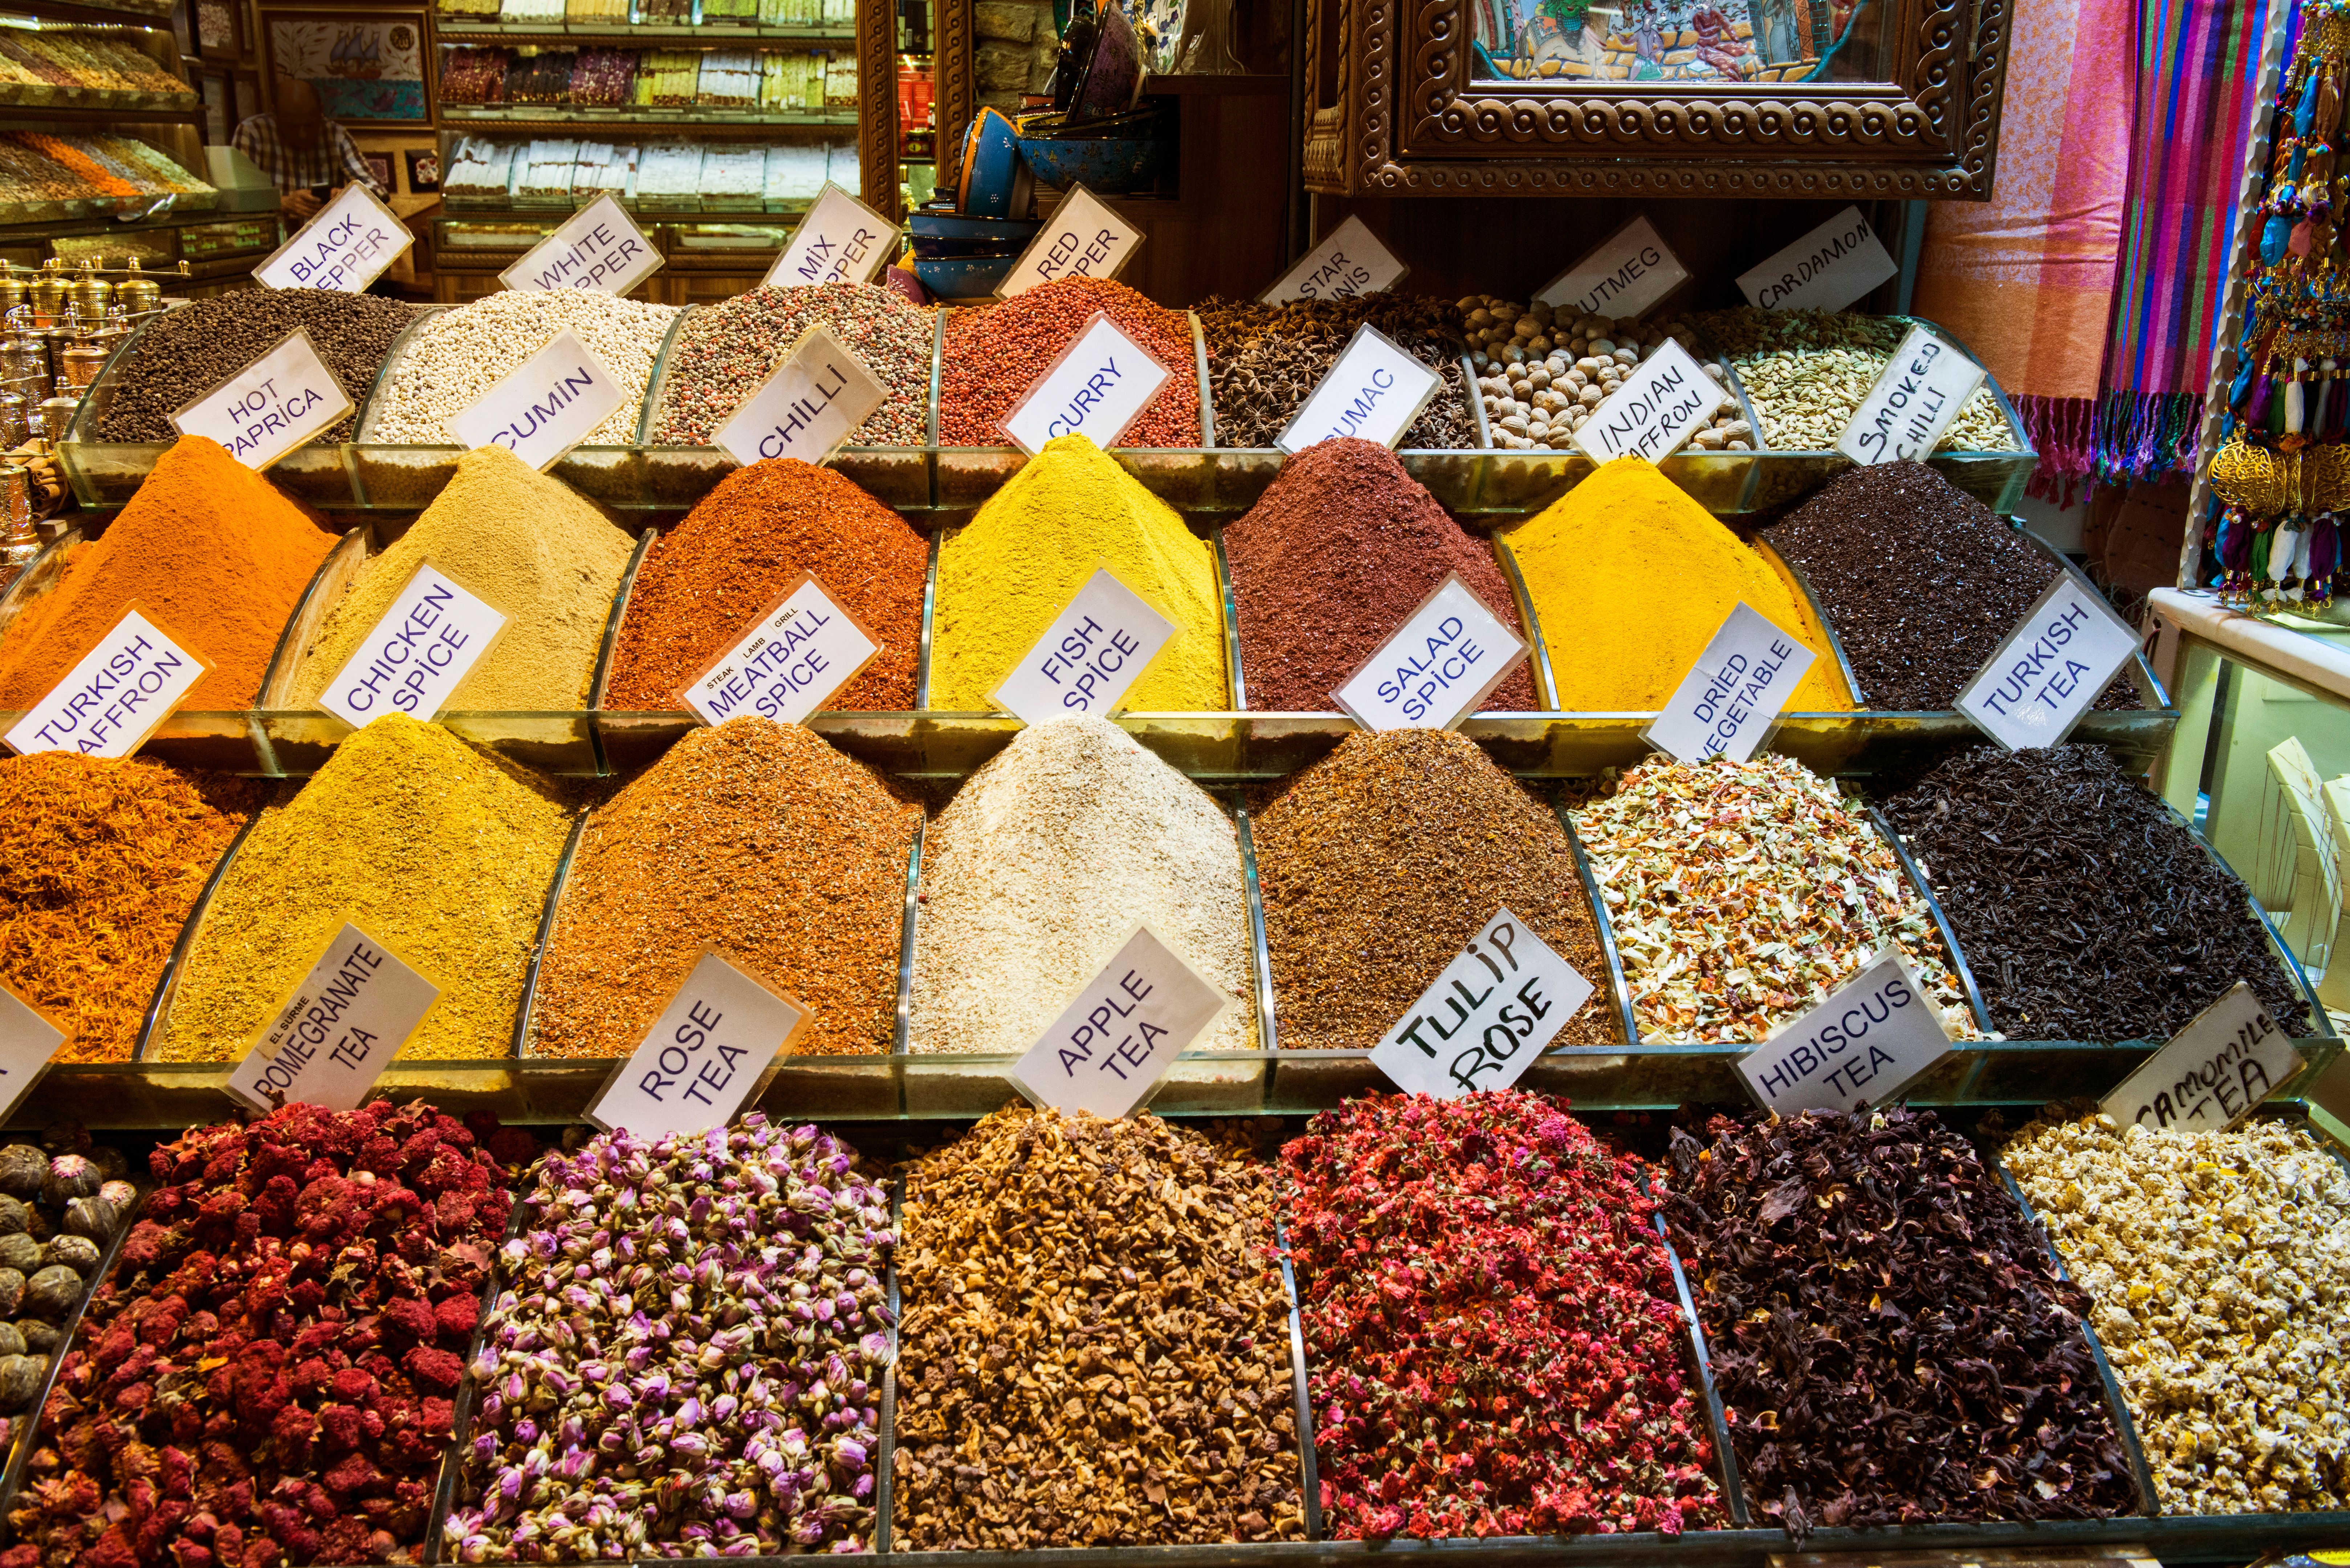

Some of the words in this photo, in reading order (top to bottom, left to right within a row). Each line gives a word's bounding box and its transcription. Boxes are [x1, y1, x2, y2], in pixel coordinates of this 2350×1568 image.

[290, 213, 362, 282] BLACK
[315, 228, 389, 291] EPPER
[574, 239, 643, 289] PPER
[826, 228, 876, 282] PPER
[1036, 232, 1079, 281] RED
[1300, 252, 1351, 299] STAR
[1575, 247, 1660, 313] UTMEG
[1759, 219, 1869, 310] CARDAMON
[228, 378, 278, 424] HOT
[1049, 356, 1121, 438] CURRY
[1600, 366, 1683, 453] INDIAN
[1859, 343, 1940, 464] SMOKED
[348, 584, 454, 711] CHICKEN
[706, 666, 734, 690] STEAK
[743, 637, 766, 658] LAMB
[774, 607, 798, 628] GRILL
[708, 610, 830, 718] MEATBALL
[1040, 616, 1103, 685] FISH
[1377, 617, 1463, 703] SALAD
[1983, 602, 2089, 715] TURKISH
[2034, 660, 2090, 709] TEA
[34, 634, 153, 745] TURKISH
[78, 651, 182, 754] AFFRON
[1695, 639, 1792, 761] VEGETABLE
[253, 943, 383, 1101] POMEGRANATE
[269, 1033, 284, 1045] EL
[281, 996, 310, 1030] SURME
[329, 1027, 378, 1070] TEA
[639, 1000, 722, 1102] ROSE
[1058, 969, 1153, 1077] APPLE
[1099, 1021, 1169, 1080] TEA
[1450, 976, 1552, 1092] ROSE
[1759, 980, 1911, 1098] HIBISCUS
[683, 1045, 749, 1106] TEA
[1822, 1046, 1895, 1097] TEA
[2187, 1059, 2270, 1119] TEA
